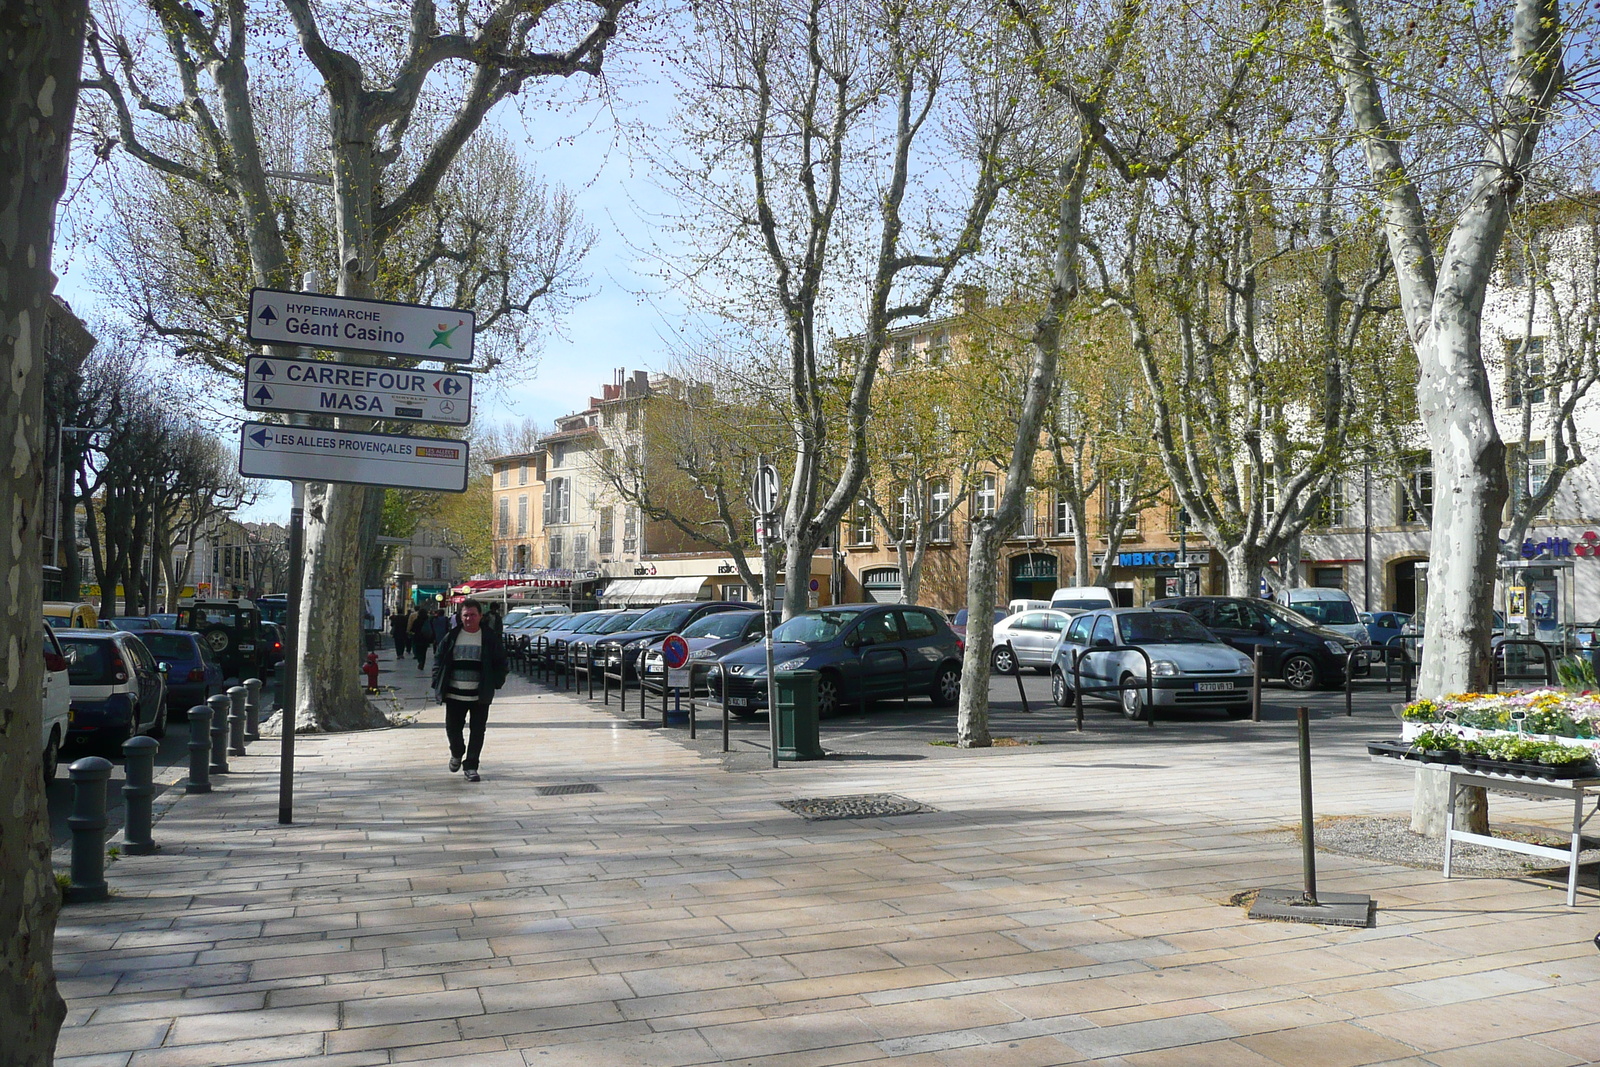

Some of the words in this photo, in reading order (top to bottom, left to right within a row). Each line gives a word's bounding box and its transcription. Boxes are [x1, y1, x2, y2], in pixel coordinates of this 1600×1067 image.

[286, 303, 380, 321] HYPERMARCHE
[286, 317, 339, 338] Géant
[344, 323, 405, 343] Casino
[287, 365, 426, 392] CARREFOUR
[320, 392, 384, 412] MASA
[275, 434, 295, 445] LES
[296, 436, 336, 448] ALLEES
[338, 439, 412, 455] PROVENÇALES
[1119, 552, 1156, 566] MBK
